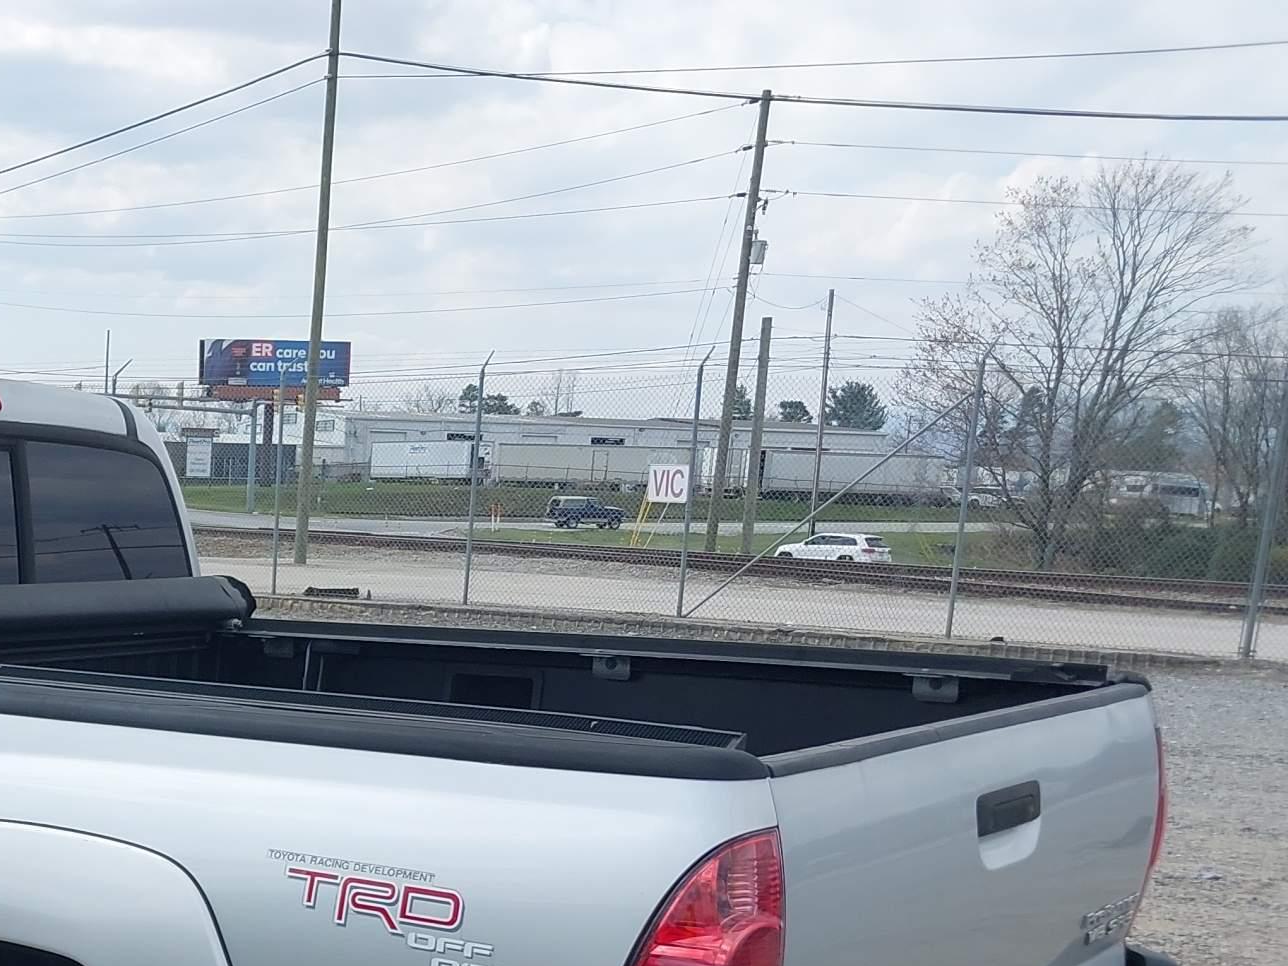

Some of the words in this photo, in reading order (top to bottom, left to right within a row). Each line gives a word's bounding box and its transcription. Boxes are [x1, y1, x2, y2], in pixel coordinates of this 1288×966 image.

[251, 343, 273, 357] ER
[276, 348, 307, 359] care
[319, 350, 335, 359] ou
[250, 361, 274, 372] can
[653, 469, 685, 498] VIC
[269, 850, 306, 865] TOYOTA
[309, 855, 350, 870] RACING
[353, 862, 436, 883] DEVELOPMENT
[286, 867, 464, 935] TRD
[407, 932, 494, 958] OFF
